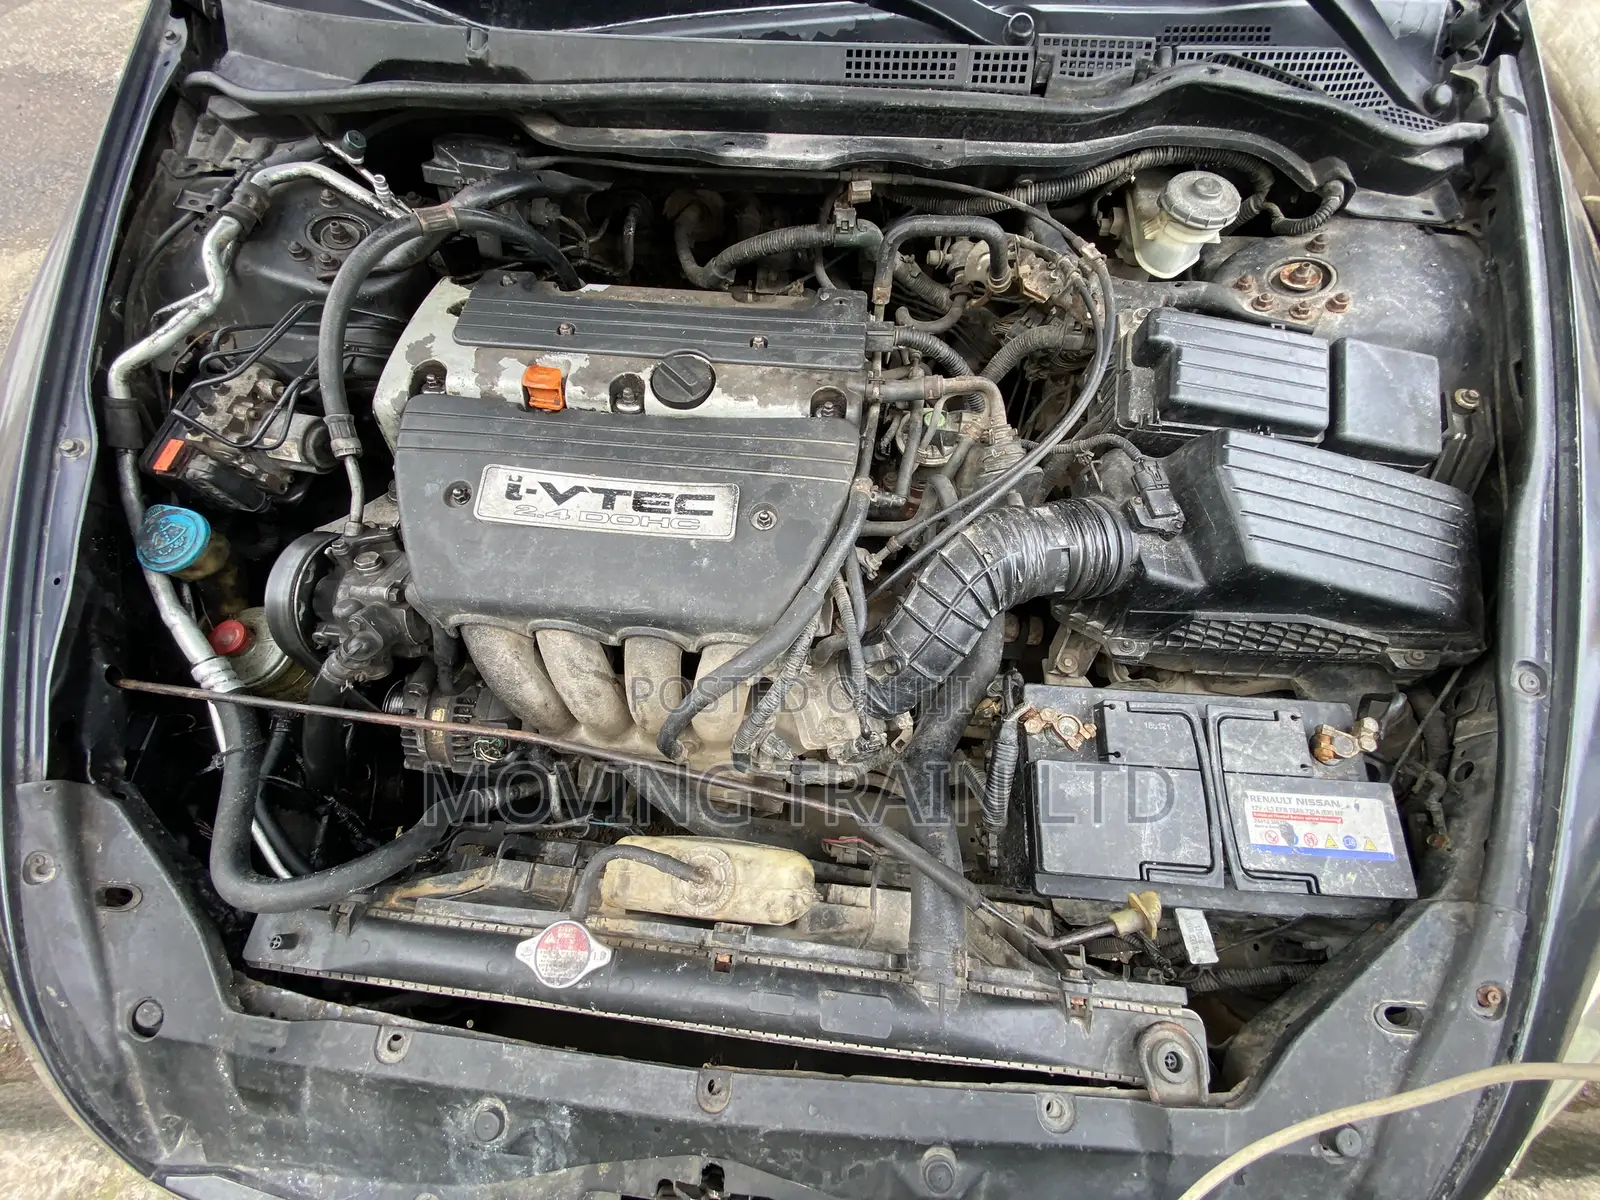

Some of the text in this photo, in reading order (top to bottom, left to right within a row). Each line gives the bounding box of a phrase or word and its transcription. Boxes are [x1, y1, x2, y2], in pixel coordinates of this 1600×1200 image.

[505, 474, 715, 516] i-VTEC
[514, 504, 701, 530] 2.4 DOHC
[1249, 794, 1341, 808] RENAULT NISSAN
